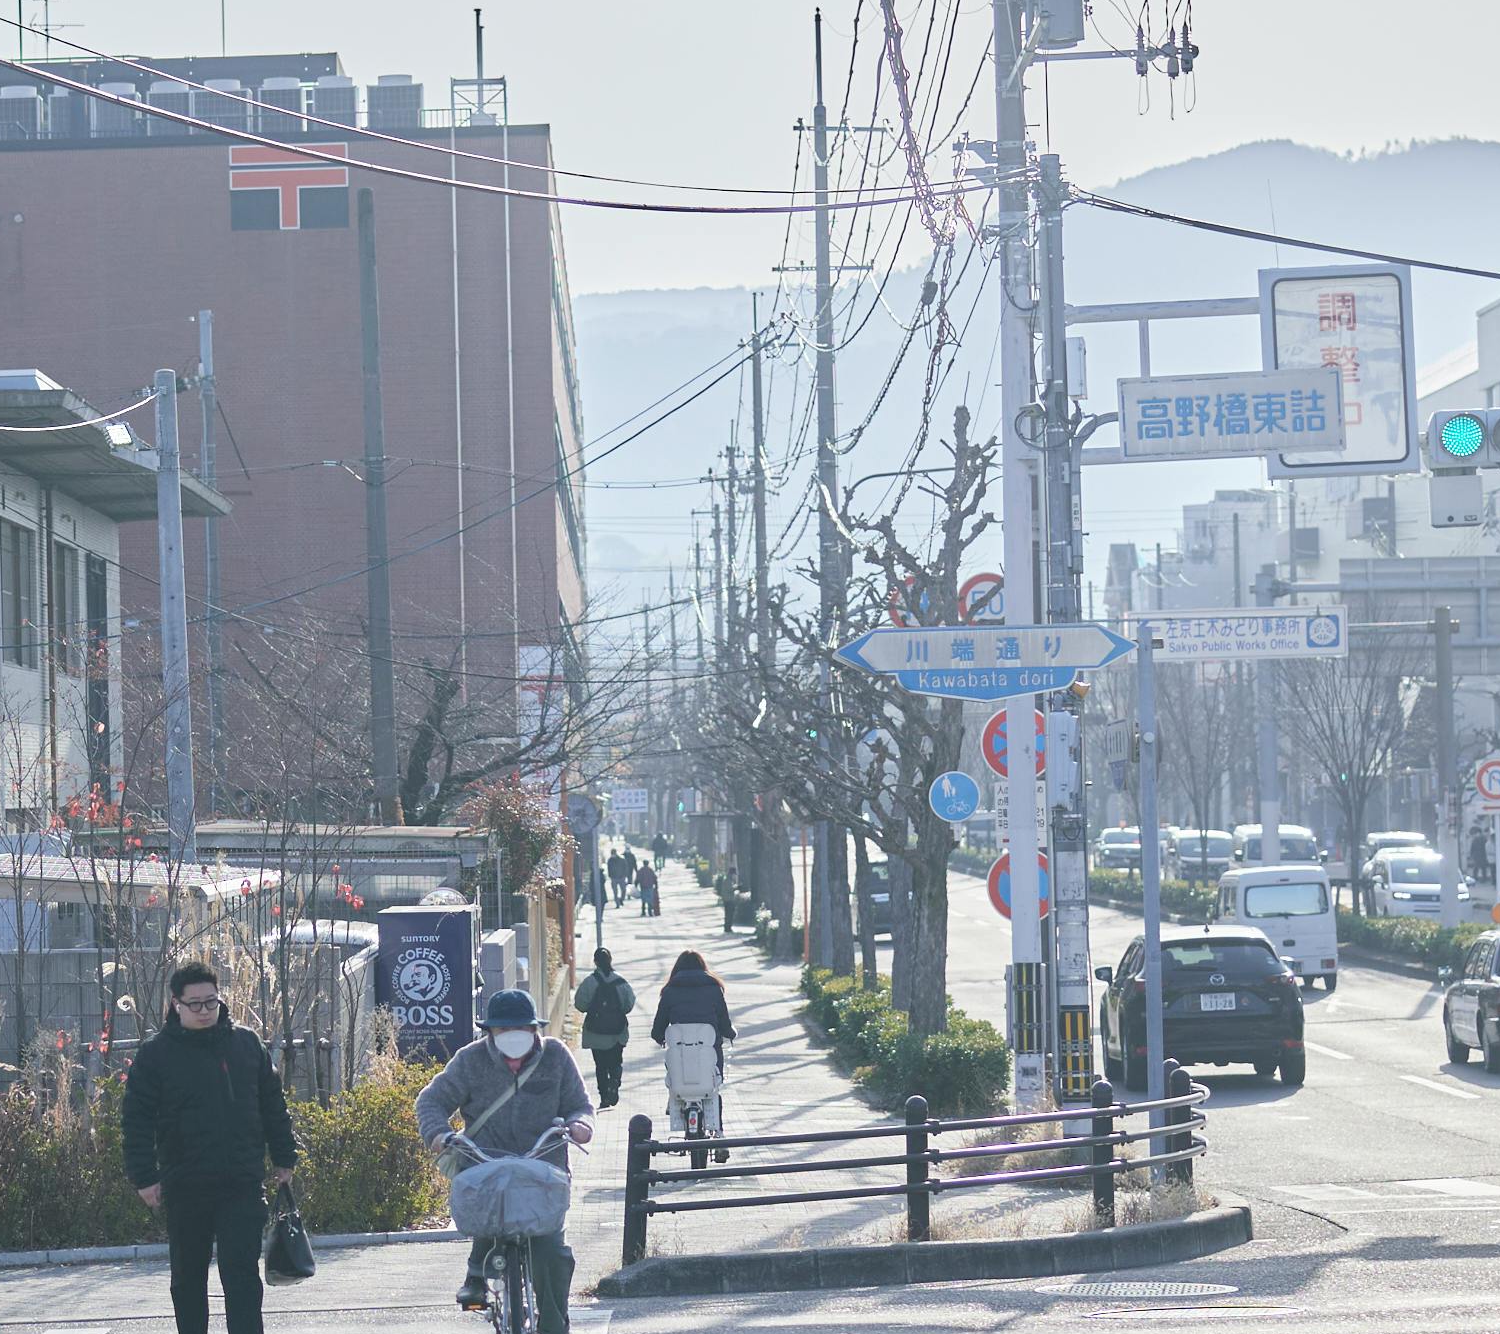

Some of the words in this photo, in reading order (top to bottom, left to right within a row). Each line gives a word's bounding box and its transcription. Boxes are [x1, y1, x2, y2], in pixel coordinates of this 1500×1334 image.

[1136, 389, 1326, 440] 高野橋東詰
[970, 589, 1004, 616] 50
[1166, 617, 1300, 639] 左京土木みどり事務所
[905, 635, 1062, 664] 川端通り
[1169, 642, 1198, 654] Sakyo
[1202, 640, 1232, 652] Public
[1236, 639, 1266, 651] Works
[1270, 638, 1299, 650] Office
[918, 671, 1008, 689] Kawabata
[1019, 669, 1055, 686] dori
[401, 935, 440, 943] SUNTORY
[397, 947, 445, 965] COFFEE
[392, 1005, 454, 1026] BOSS
